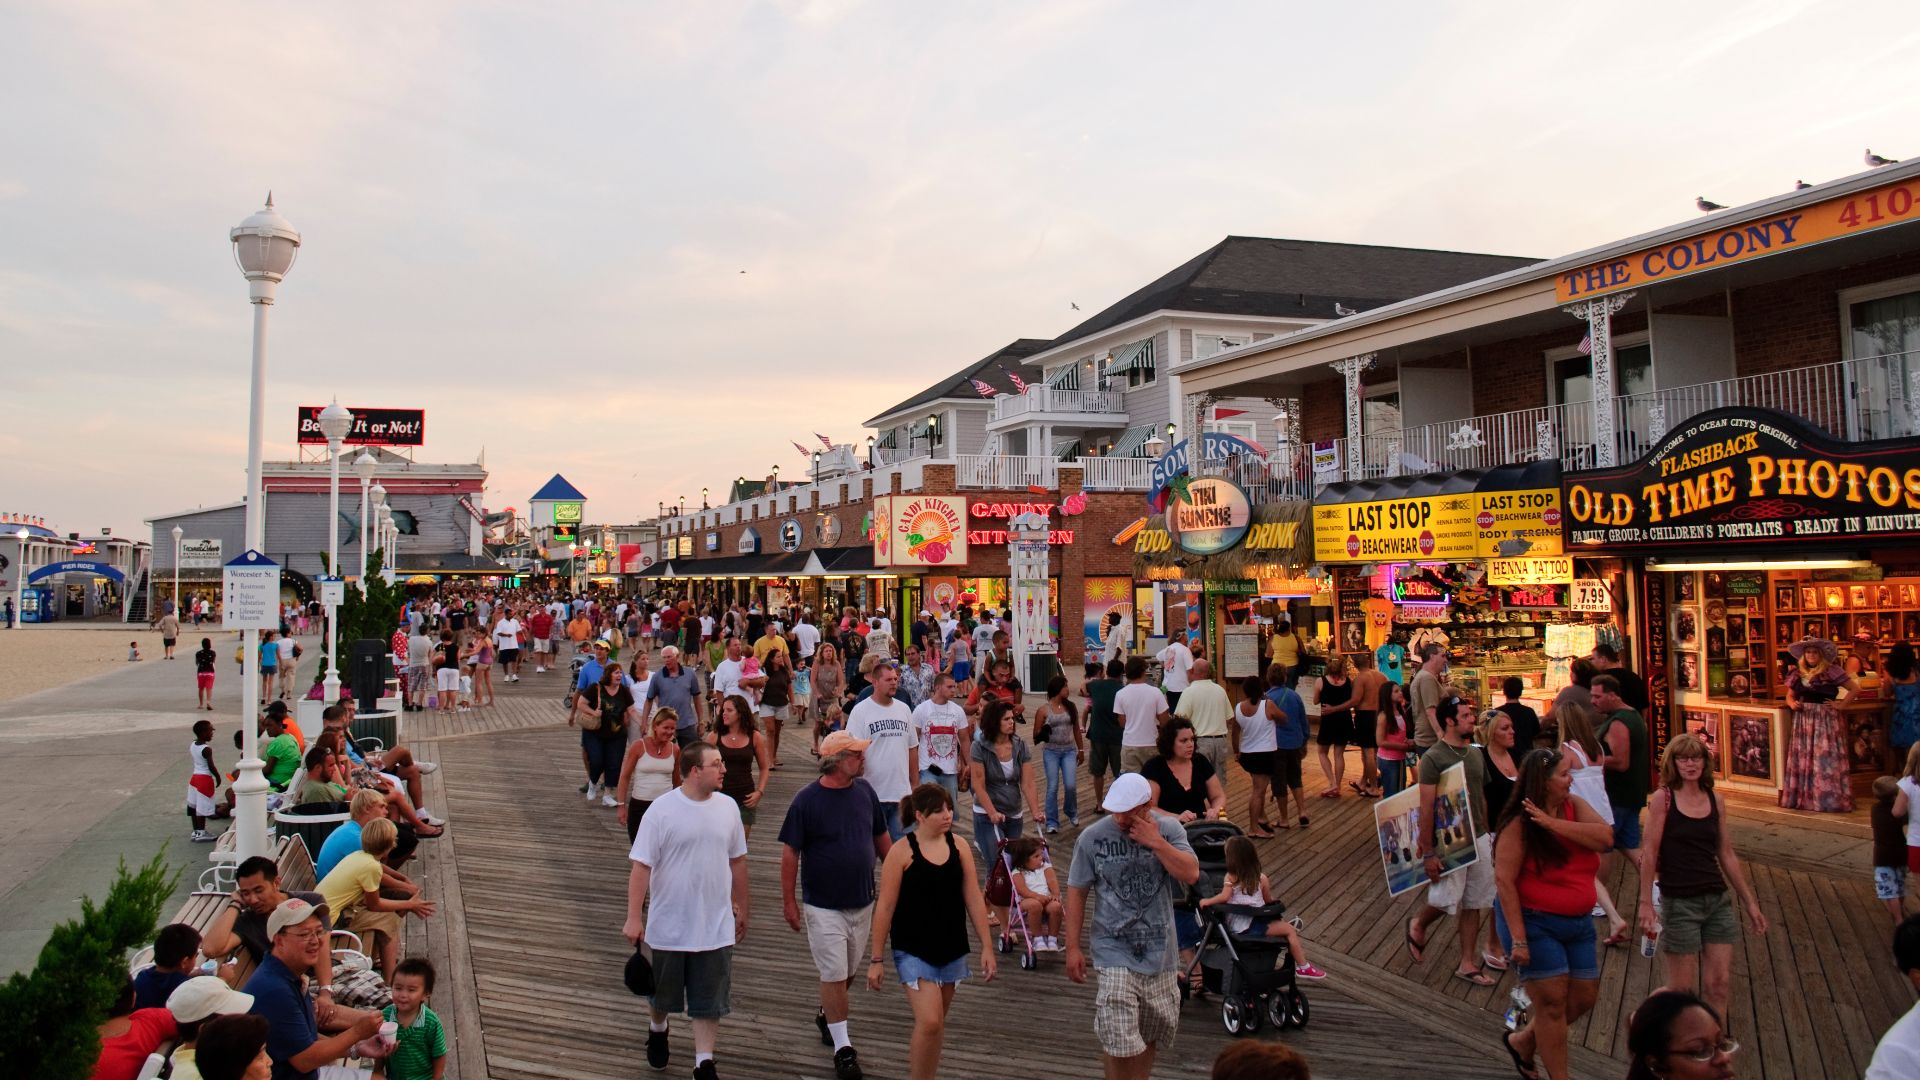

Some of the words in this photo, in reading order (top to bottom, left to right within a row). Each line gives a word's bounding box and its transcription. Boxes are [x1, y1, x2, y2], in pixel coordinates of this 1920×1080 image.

[1563, 260, 1631, 297] THE
[1642, 215, 1802, 277] COLONY
[1838, 187, 1920, 228] 410-
[354, 420, 367, 433] It
[371, 424, 387, 434] or
[388, 421, 419, 434] Not!
[1649, 434, 1685, 467] WELCOME
[1686, 427, 1698, 438] TO
[1699, 418, 1728, 432] OCEAN
[1730, 418, 1757, 429] CITY'S
[1758, 423, 1798, 450] ORIGINAL
[1660, 431, 1759, 478] FLASHBACK
[1191, 485, 1217, 507] TIKI
[1569, 485, 1634, 526] OLD
[1642, 466, 1737, 524] TIME
[1746, 455, 1920, 510] PHOTOS
[1482, 496, 1513, 510] LAST
[1520, 493, 1554, 508] STOP
[898, 500, 922, 533] CANDY
[924, 498, 961, 533] KITCHEN
[971, 502, 1055, 518] CANDY
[1180, 506, 1231, 530] SUNRISE
[1348, 505, 1383, 531] LAST
[1389, 501, 1431, 530] STOP
[1495, 512, 1543, 522] BEACHWEAR
[1544, 513, 1560, 521] STOP
[1572, 529, 1608, 544] FAMILY,
[1608, 528, 1642, 543] GROUP,
[1642, 530, 1649, 540] &
[1649, 524, 1714, 540] CHILDREN'S
[1717, 521, 1783, 538] PORTRAITS
[1794, 518, 1839, 535] READY
[1844, 517, 1861, 532] IN
[967, 530, 1074, 545] KITEN
[1135, 529, 1173, 553] FOOD
[1245, 522, 1300, 550] DRINK
[1479, 530, 1508, 539] BODY
[1347, 543, 1360, 551] STOP
[1362, 537, 1418, 555] BEACHWEAR
[1420, 538, 1434, 548] STOP
[1492, 545, 1499, 553] &
[230, 570, 262, 578] Worcester
[1493, 561, 1529, 576] HENNA
[1532, 560, 1569, 575] TATTOO
[1183, 582, 1203, 592] nachos
[1204, 580, 1223, 592] Pulled
[1405, 581, 1441, 596] JEWEL
[1403, 607, 1414, 618] EAR
[1414, 606, 1439, 618] PIERCING
